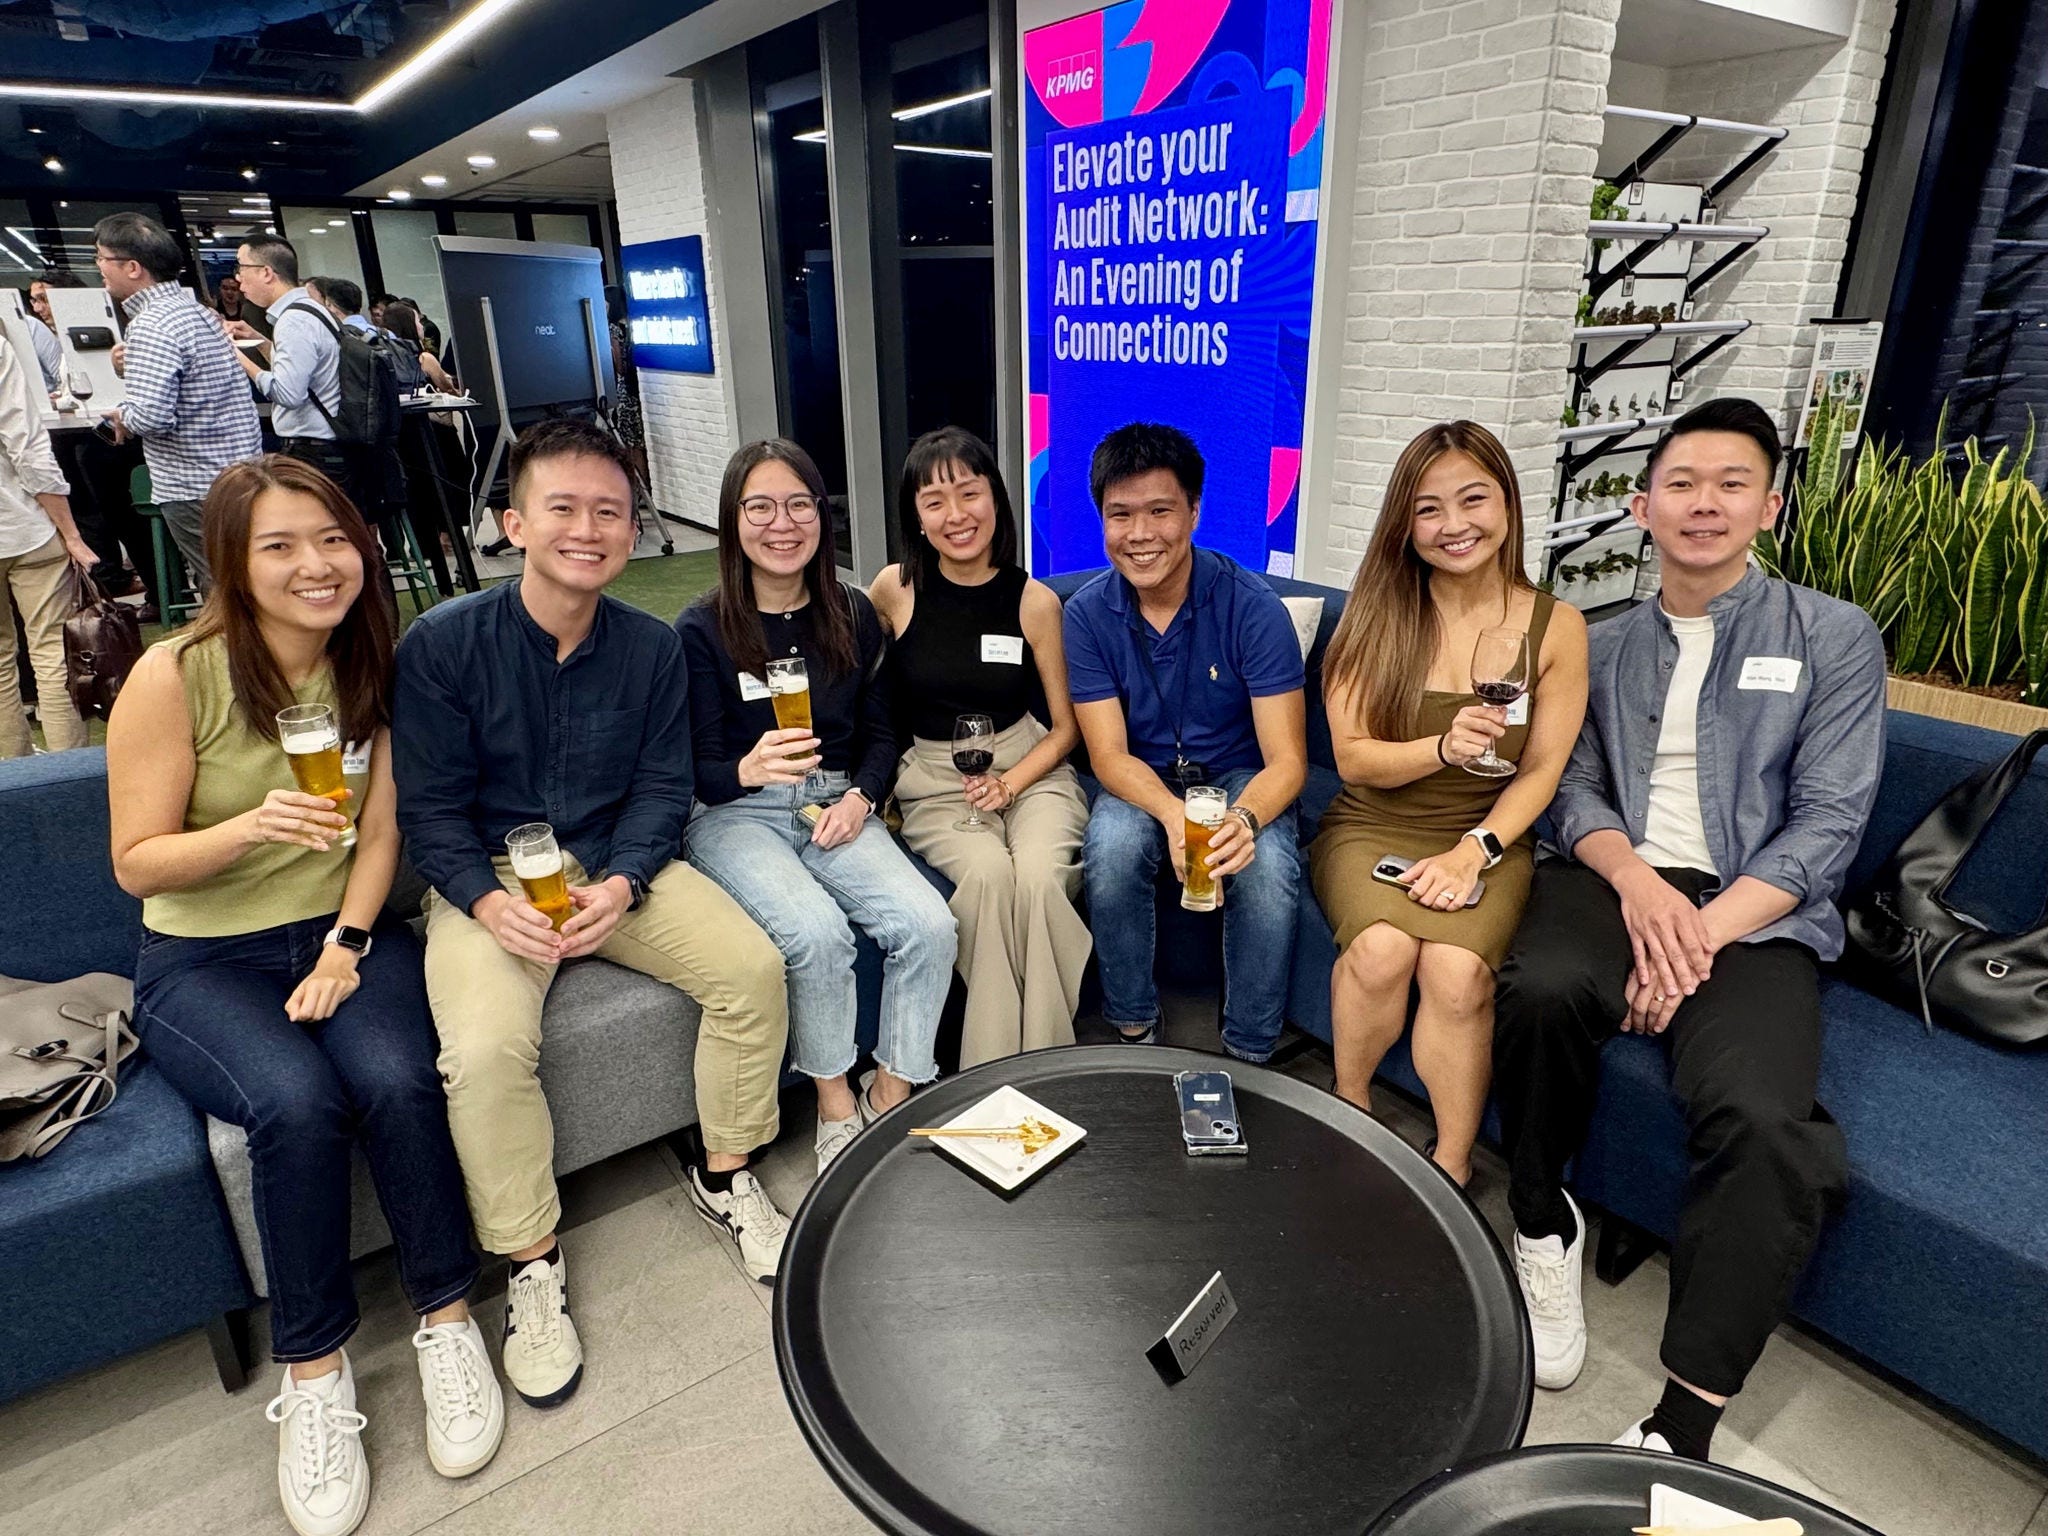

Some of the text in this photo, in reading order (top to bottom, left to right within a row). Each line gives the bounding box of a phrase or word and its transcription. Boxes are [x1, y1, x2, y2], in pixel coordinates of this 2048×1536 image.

[1045, 66, 1095, 99] KPMG
[1053, 121, 1233, 194] Elevate your
[1053, 179, 1269, 250] Audit Network:
[1053, 248, 1244, 311] An Evening of
[534, 324, 557, 336] neat
[1054, 314, 1229, 367] Connections
[1178, 1291, 1229, 1355] Reserved
